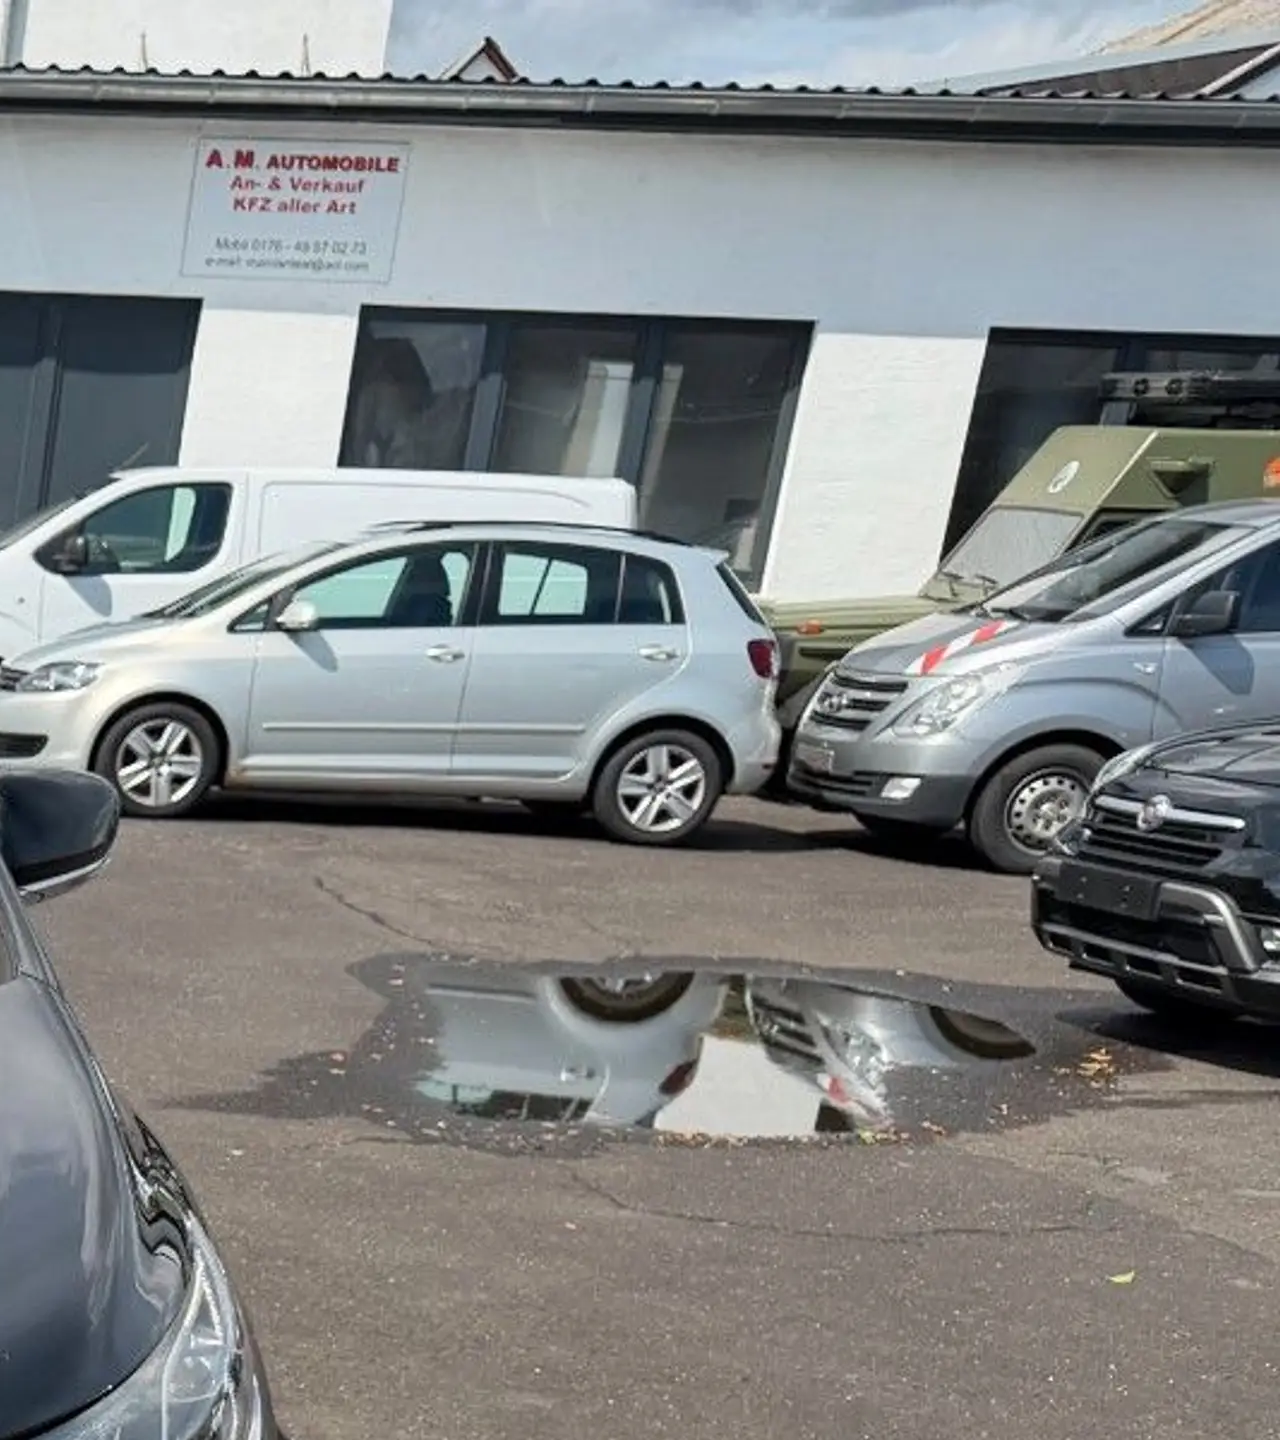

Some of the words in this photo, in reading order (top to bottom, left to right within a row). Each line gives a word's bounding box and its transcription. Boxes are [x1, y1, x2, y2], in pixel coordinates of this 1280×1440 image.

[266, 154, 400, 173] AUTOMOBILE
[230, 174, 262, 191] An-
[268, 176, 282, 192] &
[290, 177, 365, 194] Verkauf
[232, 196, 272, 213] KFZ
[277, 198, 318, 214] aller
[325, 199, 357, 215] Art
